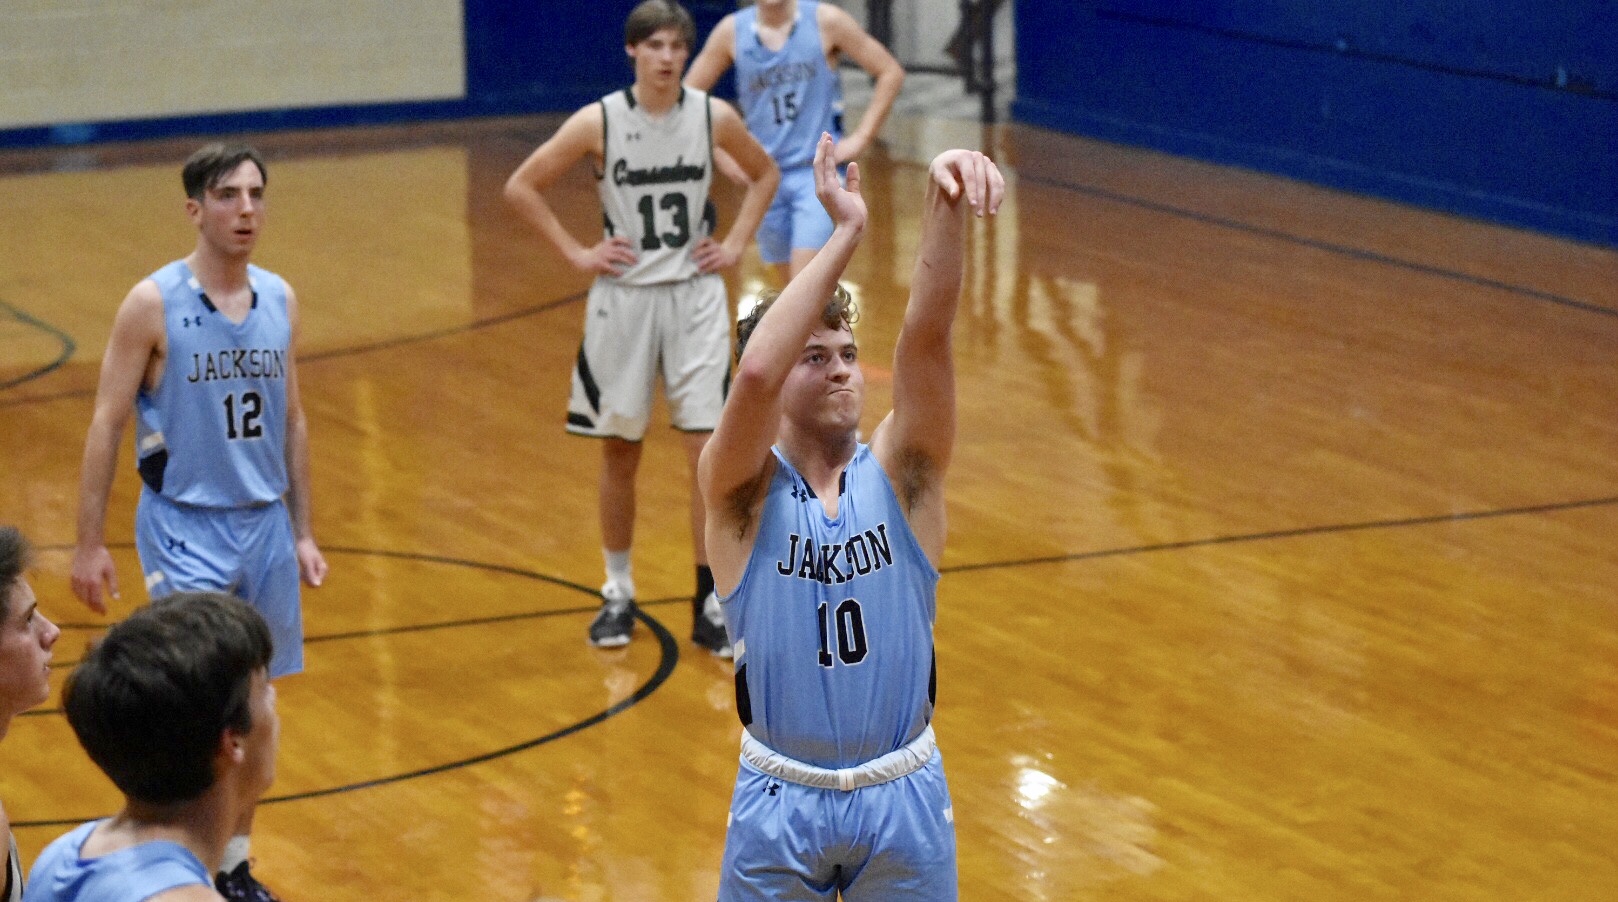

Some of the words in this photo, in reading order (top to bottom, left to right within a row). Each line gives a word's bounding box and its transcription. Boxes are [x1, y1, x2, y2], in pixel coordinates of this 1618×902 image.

[772, 92, 799, 125] 15
[637, 191, 690, 251] 13
[186, 349, 285, 383] JACKSON
[222, 390, 264, 439] 12
[816, 597, 868, 669] 10
